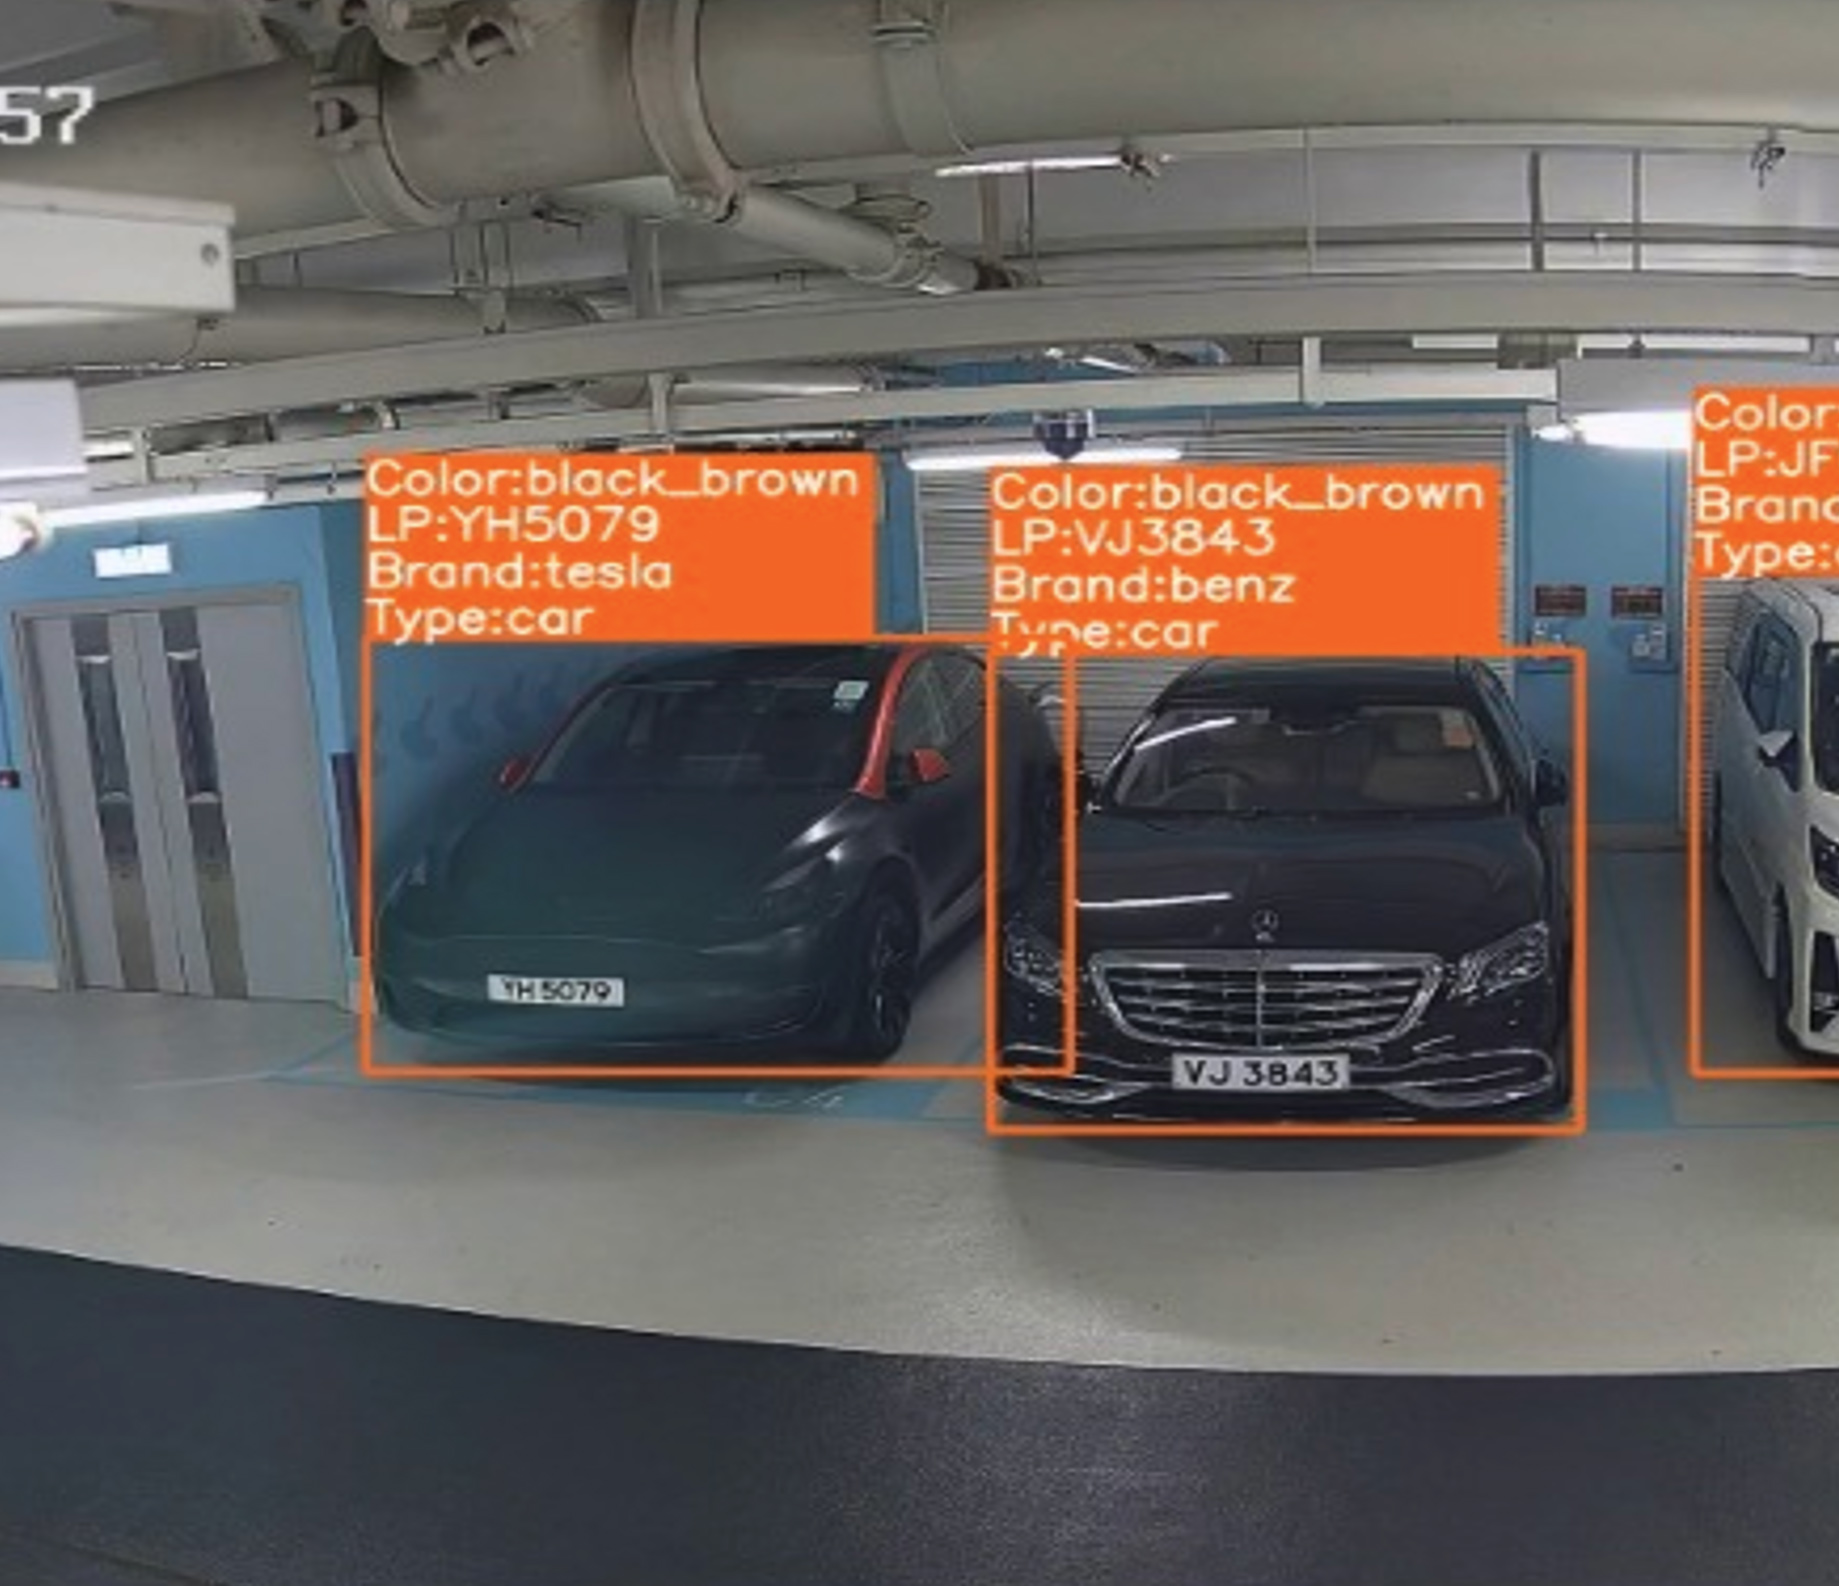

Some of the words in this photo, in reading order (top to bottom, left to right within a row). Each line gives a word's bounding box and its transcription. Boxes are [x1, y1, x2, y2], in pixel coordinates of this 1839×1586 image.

[501, 977, 534, 1000] YH
[542, 980, 612, 1001] 5079
[1184, 1059, 1231, 1086] VJ
[1243, 1060, 1339, 1086] 3843
